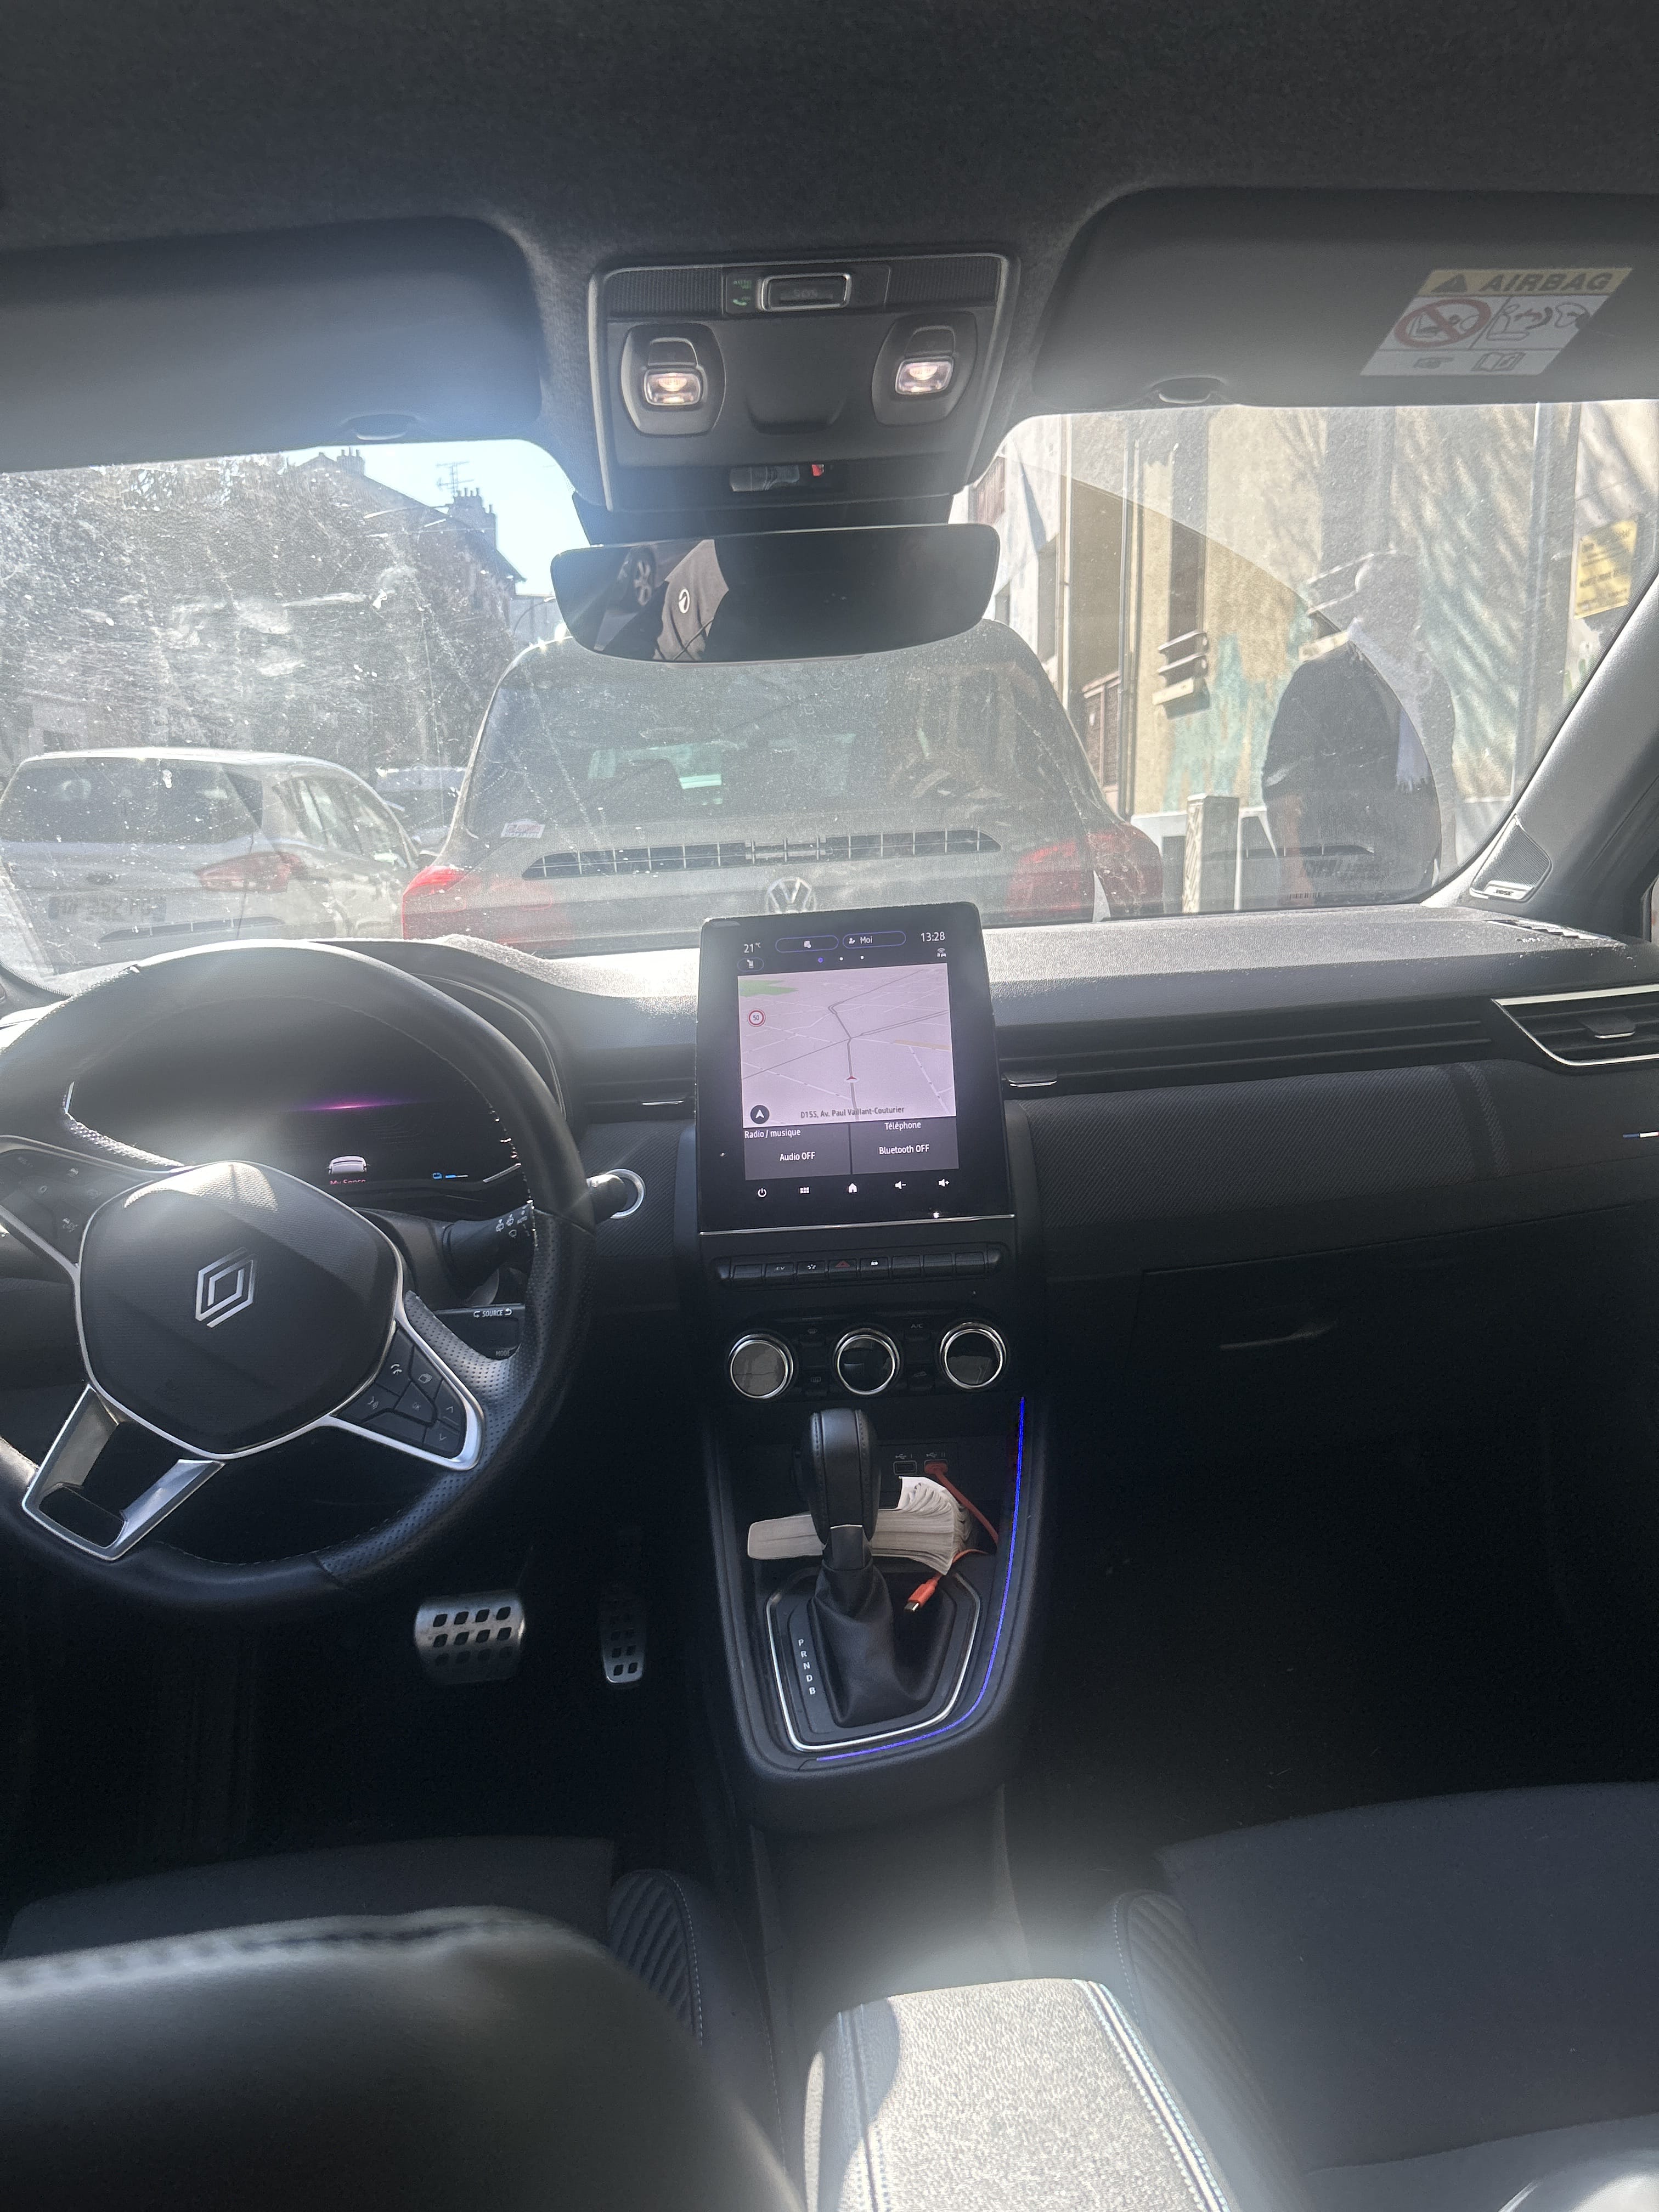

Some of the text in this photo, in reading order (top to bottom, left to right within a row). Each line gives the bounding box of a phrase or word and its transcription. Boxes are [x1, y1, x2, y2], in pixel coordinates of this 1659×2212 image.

[1481, 273, 1613, 292] AIRBAG
[860, 936, 873, 944] Moi
[921, 932, 945, 942] 13:28
[848, 1106, 905, 1115] Vaillant-Couturier
[884, 1121, 921, 1131] Téléphone
[744, 1130, 765, 1138] Radio
[770, 1128, 801, 1138] musique
[879, 1144, 929, 1155] Bluetooth OFF
[780, 1152, 816, 1161] Audio OFF
[412, 1402, 422, 1412] OK
